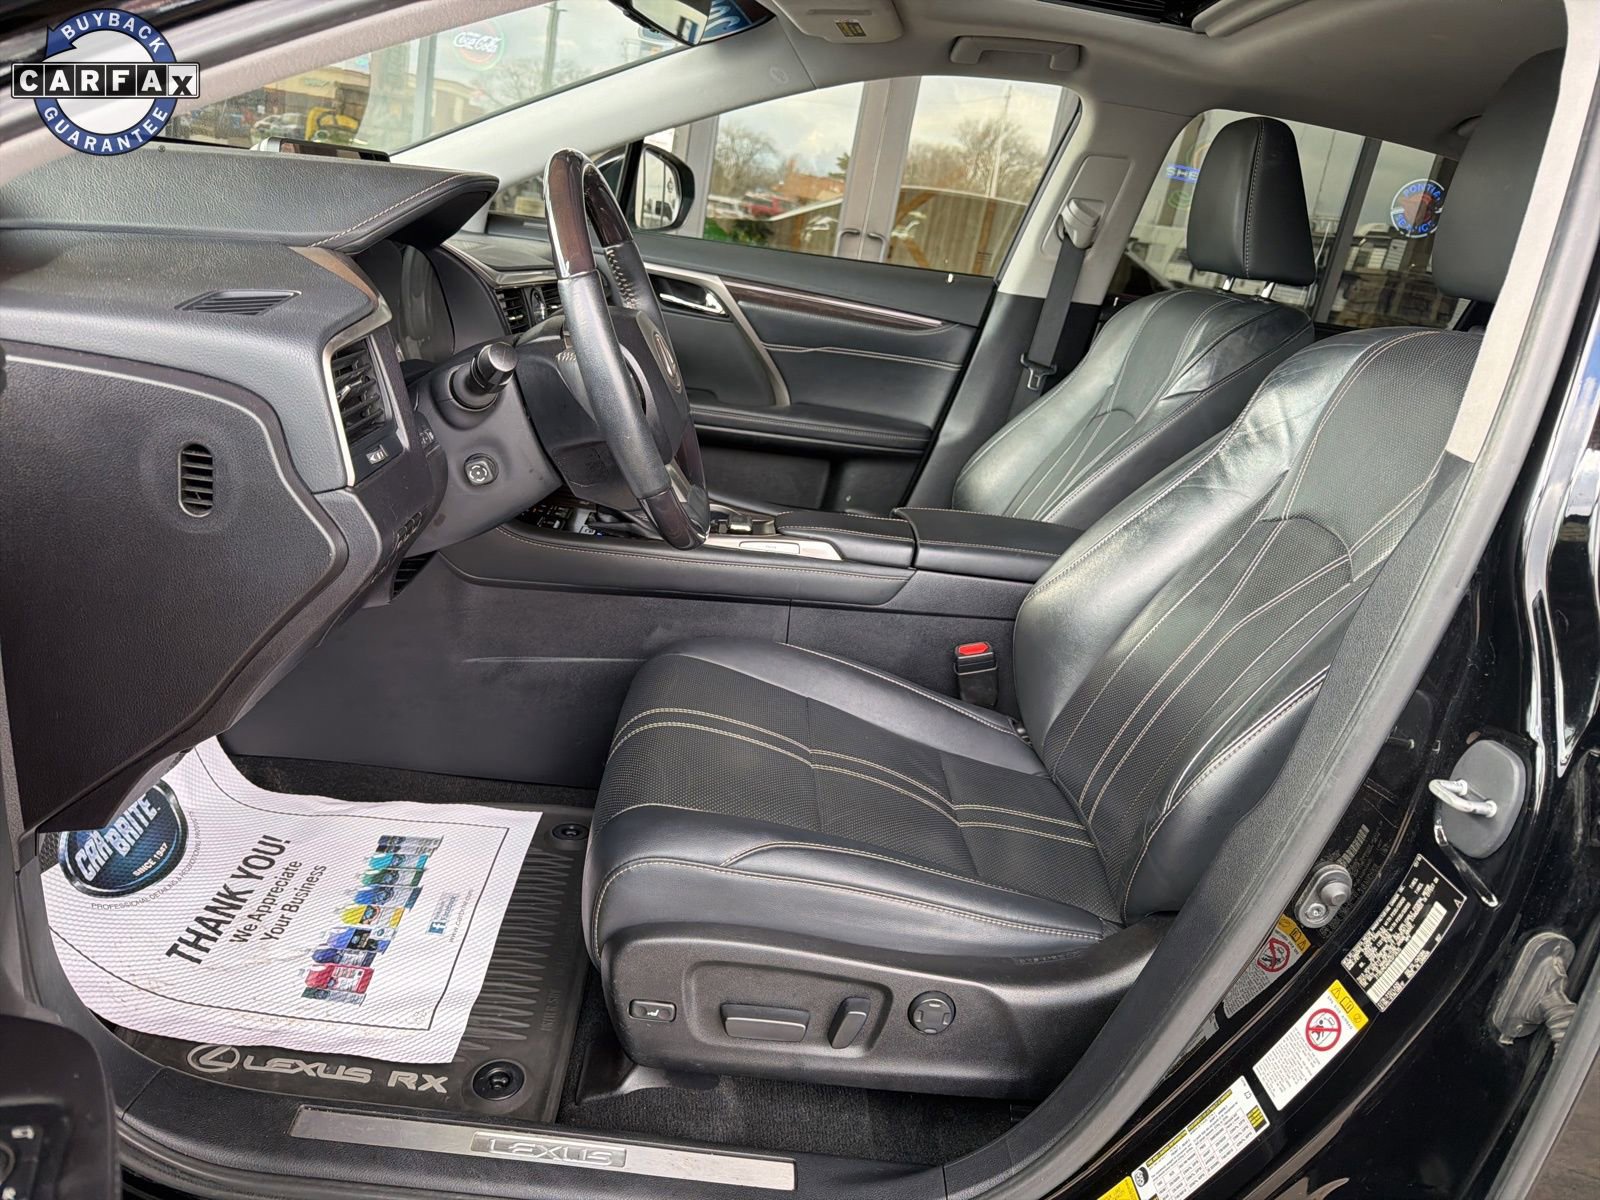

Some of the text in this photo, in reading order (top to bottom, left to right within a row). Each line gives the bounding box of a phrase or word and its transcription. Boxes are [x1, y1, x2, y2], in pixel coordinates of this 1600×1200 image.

[1402, 183, 1442, 202] PONTIA
[104, 793, 157, 857] BRITE
[132, 842, 168, 877] SINCE 1947
[165, 835, 291, 965] THANK YOU!
[229, 861, 303, 943] We Appreciate
[260, 865, 327, 941] Your Business
[242, 1055, 449, 1094] LEXUS RX
[489, 1139, 613, 1166] LEXUS
